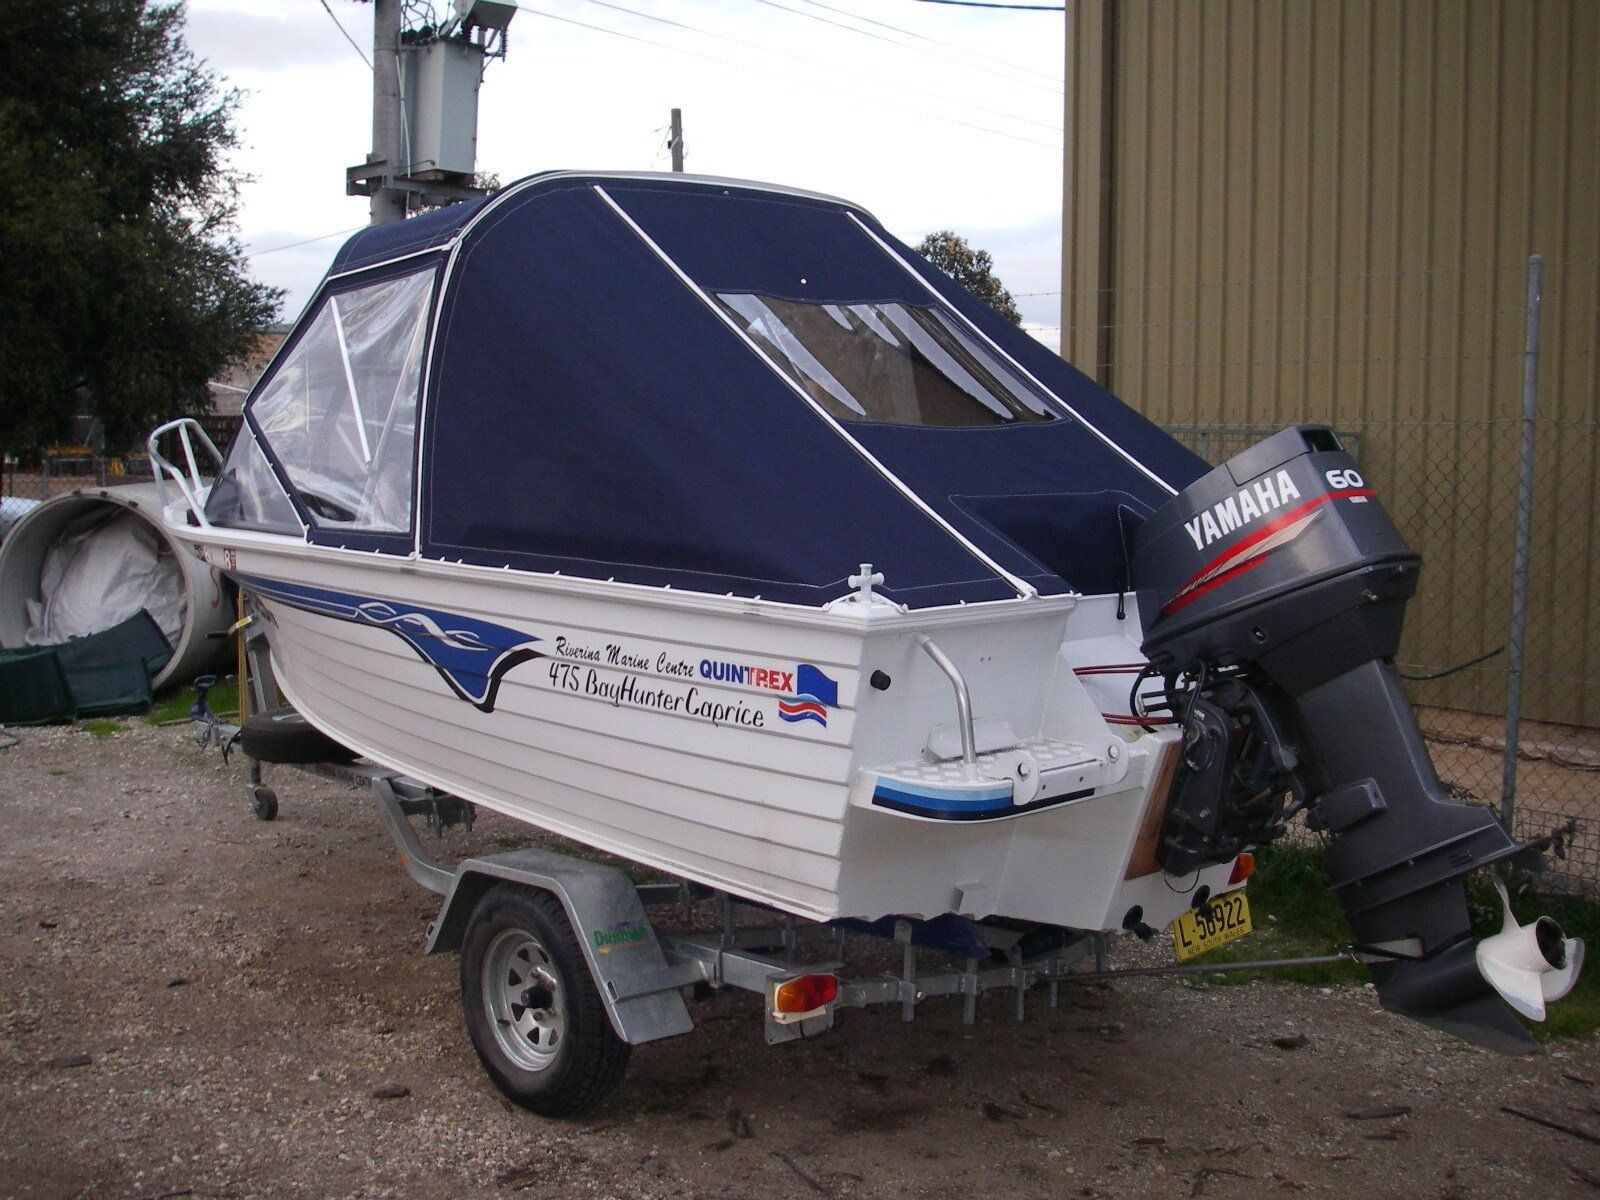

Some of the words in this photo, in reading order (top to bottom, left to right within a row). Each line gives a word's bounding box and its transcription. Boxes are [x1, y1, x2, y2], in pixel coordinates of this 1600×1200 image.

[1325, 468, 1364, 489] 60
[1184, 469, 1301, 551] YAMAHA
[556, 636, 600, 661] Riverina
[606, 643, 650, 670] Marine
[656, 651, 695, 678] Centre
[549, 661, 580, 692] 475
[699, 659, 793, 692] QUINTREX
